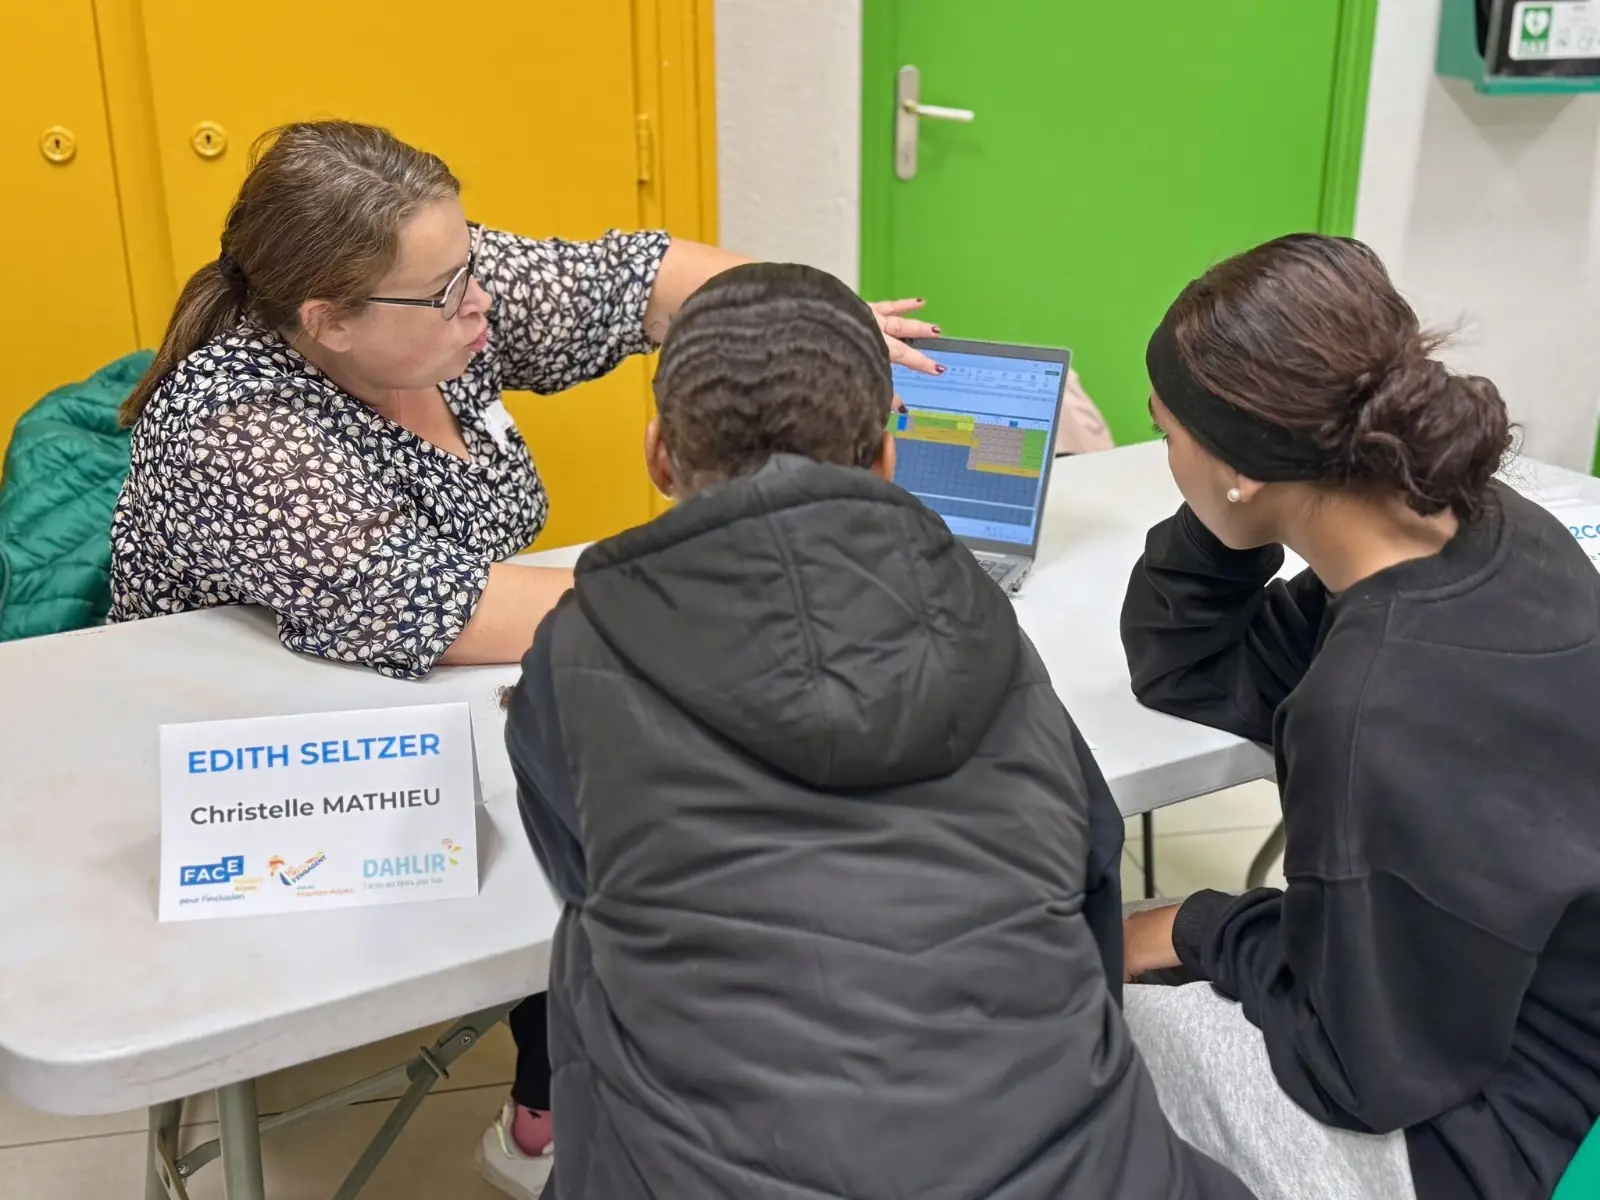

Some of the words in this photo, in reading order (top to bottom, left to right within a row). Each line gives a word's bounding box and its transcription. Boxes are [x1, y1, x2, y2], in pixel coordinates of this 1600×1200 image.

[188, 744, 289, 774] EDITH
[300, 733, 440, 765] SELTZER
[190, 798, 314, 825] Christelle
[323, 788, 441, 815] MATHIEU
[183, 859, 239, 882] FACE
[363, 853, 445, 878] DAHLIR
[179, 896, 199, 906] pour
[201, 893, 245, 903] l'inclusion
